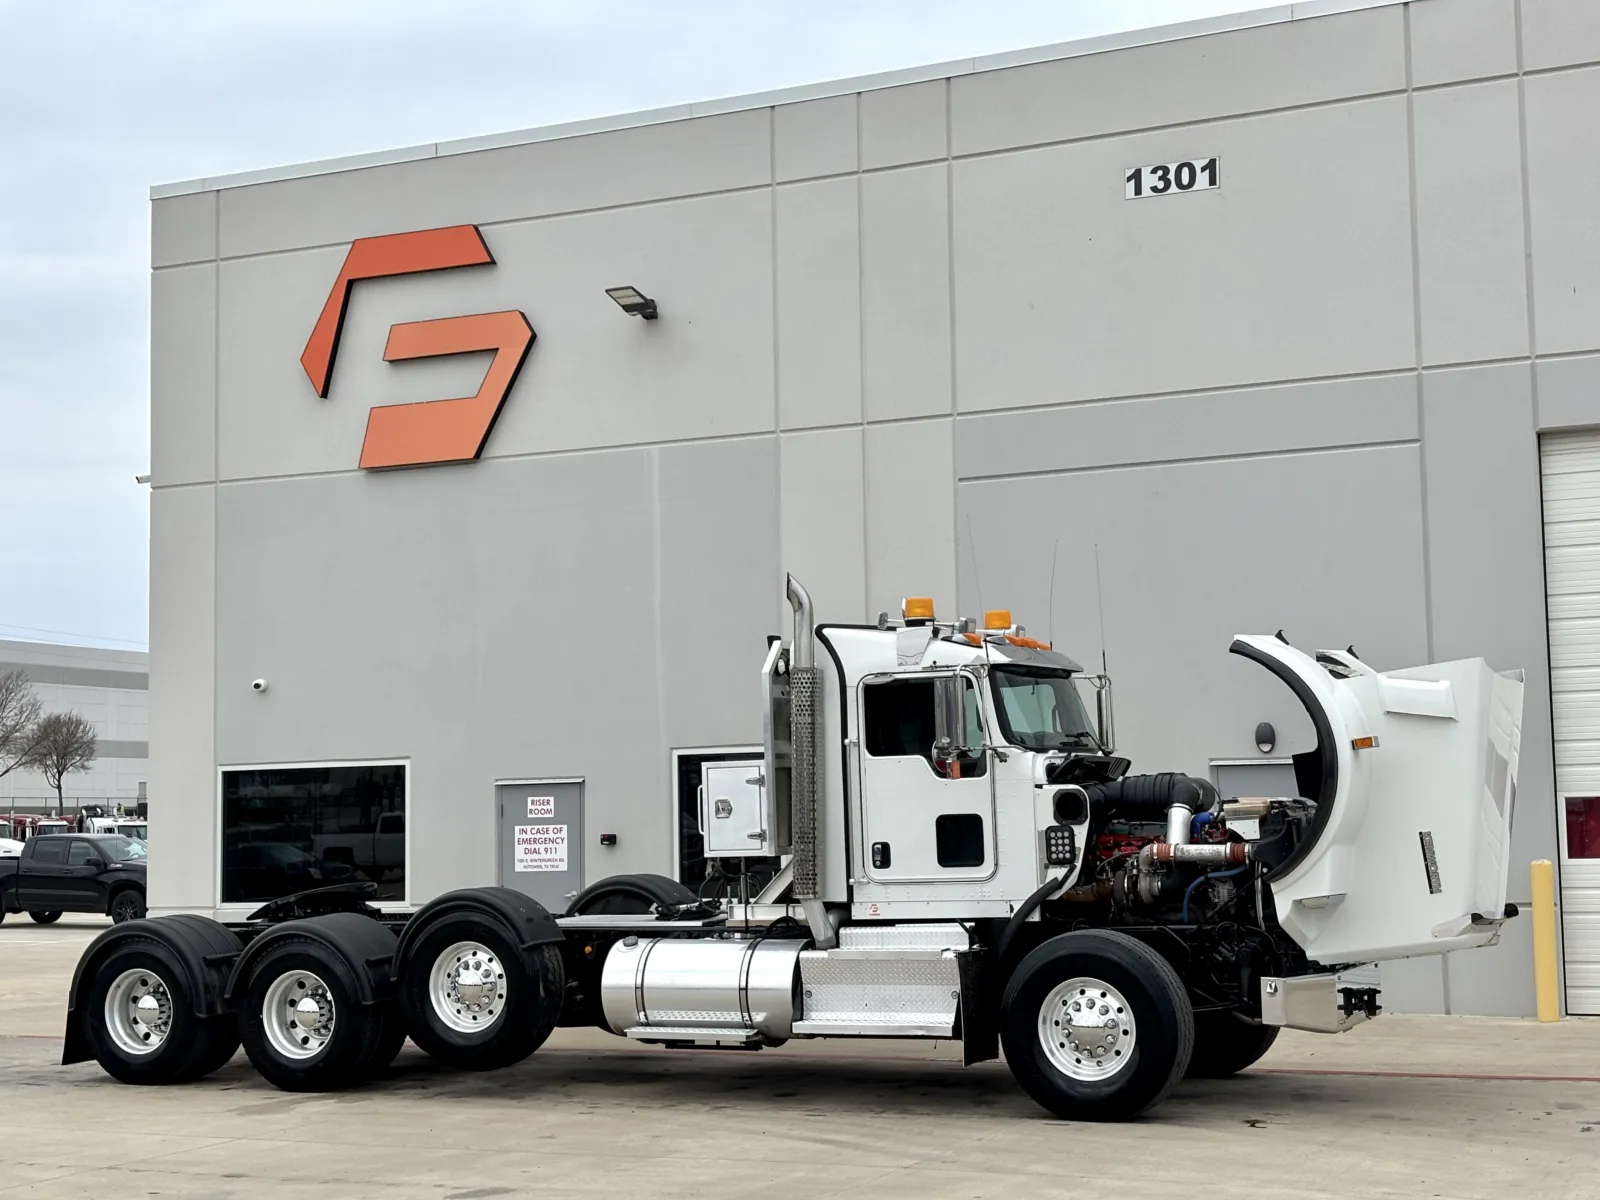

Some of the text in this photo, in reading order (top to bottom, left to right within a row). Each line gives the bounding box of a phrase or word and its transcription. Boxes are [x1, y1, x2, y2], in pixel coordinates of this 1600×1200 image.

[1126, 158, 1217, 197] 1301
[530, 827, 550, 835] CASE
[517, 837, 565, 845] EMERGENCY
[524, 847, 542, 855] DIAL
[1420, 831, 1442, 893] KENWORTH
